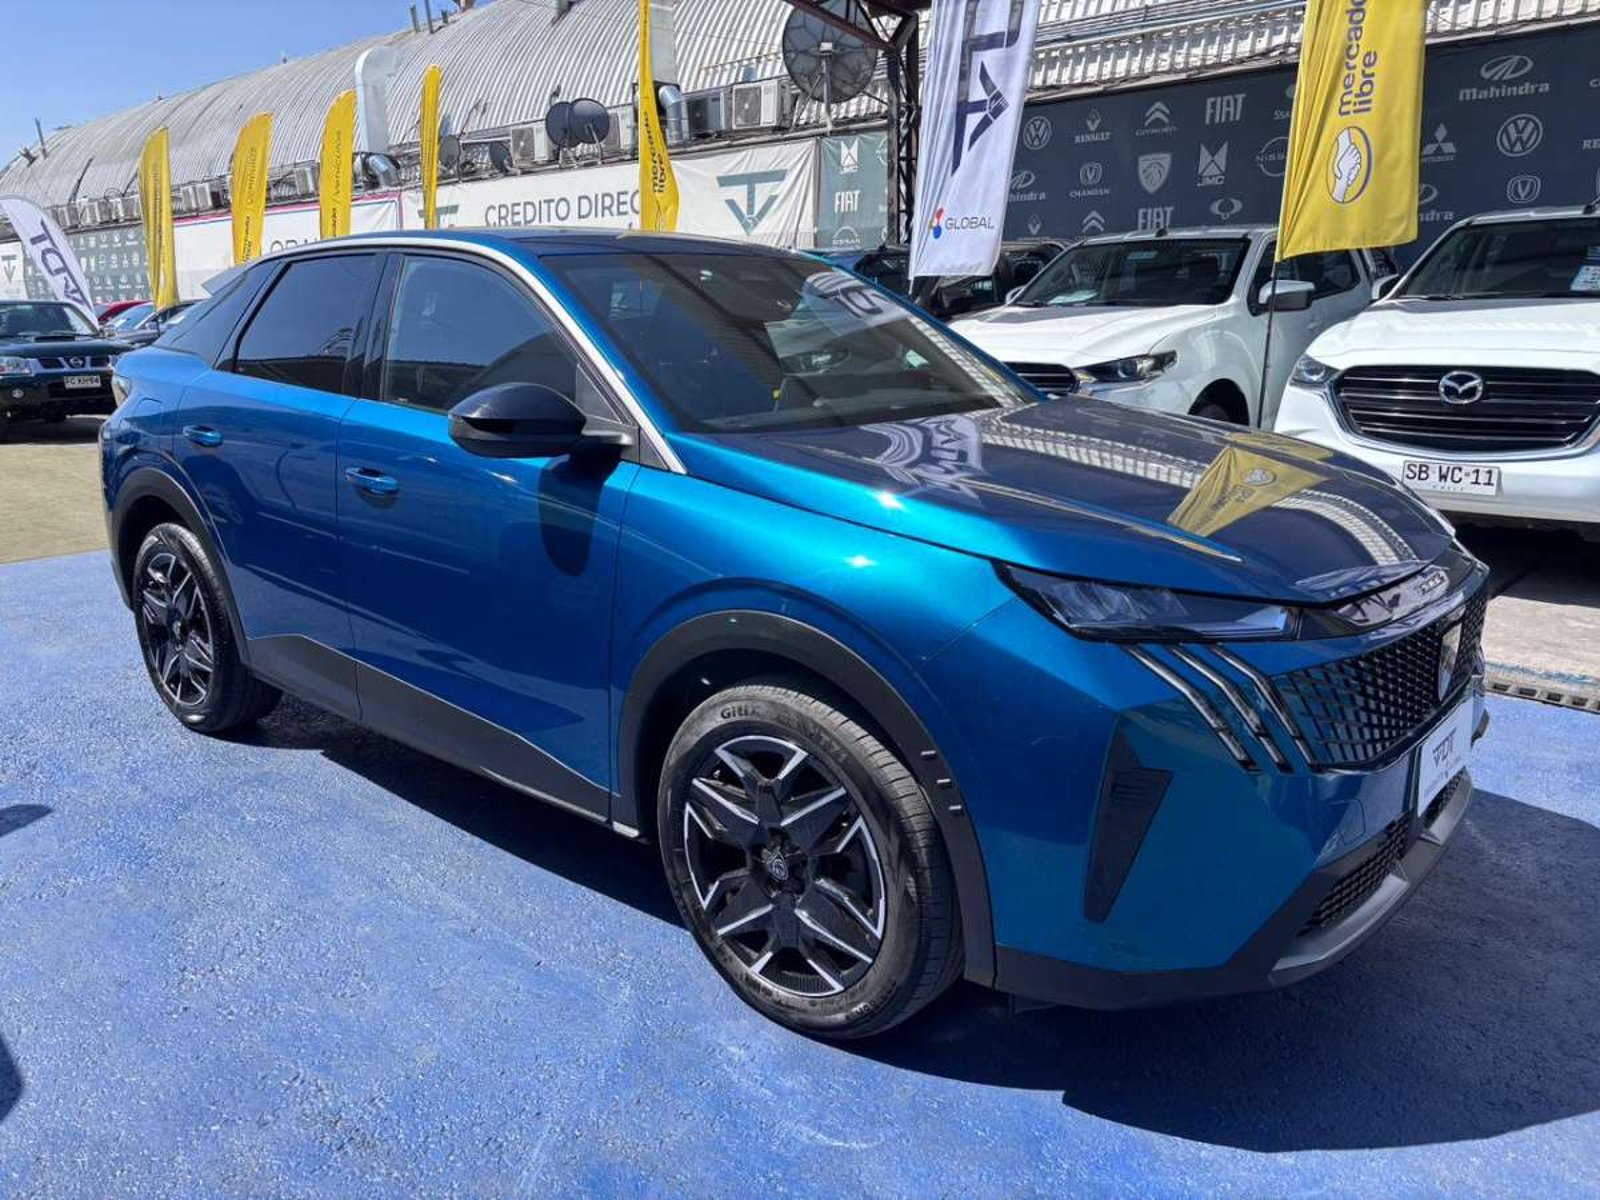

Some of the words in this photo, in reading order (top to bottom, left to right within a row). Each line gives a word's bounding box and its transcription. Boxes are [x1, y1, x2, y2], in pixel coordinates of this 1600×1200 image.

[1352, 50, 1378, 115] libre
[1458, 81, 1550, 101] Mahindra
[1204, 93, 1246, 125] FIAT
[643, 110, 660, 194] mercado
[657, 152, 667, 193] libre
[1196, 175, 1226, 187] JMC
[485, 197, 571, 226] CREDITO
[577, 190, 640, 220] DIREC
[834, 190, 861, 214] FIAT
[944, 216, 995, 230] GLOBAL
[1138, 206, 1174, 231] FIAT
[1405, 463, 1430, 481] SB
[1438, 466, 1462, 484] WC
[1470, 469, 1495, 487] 11
